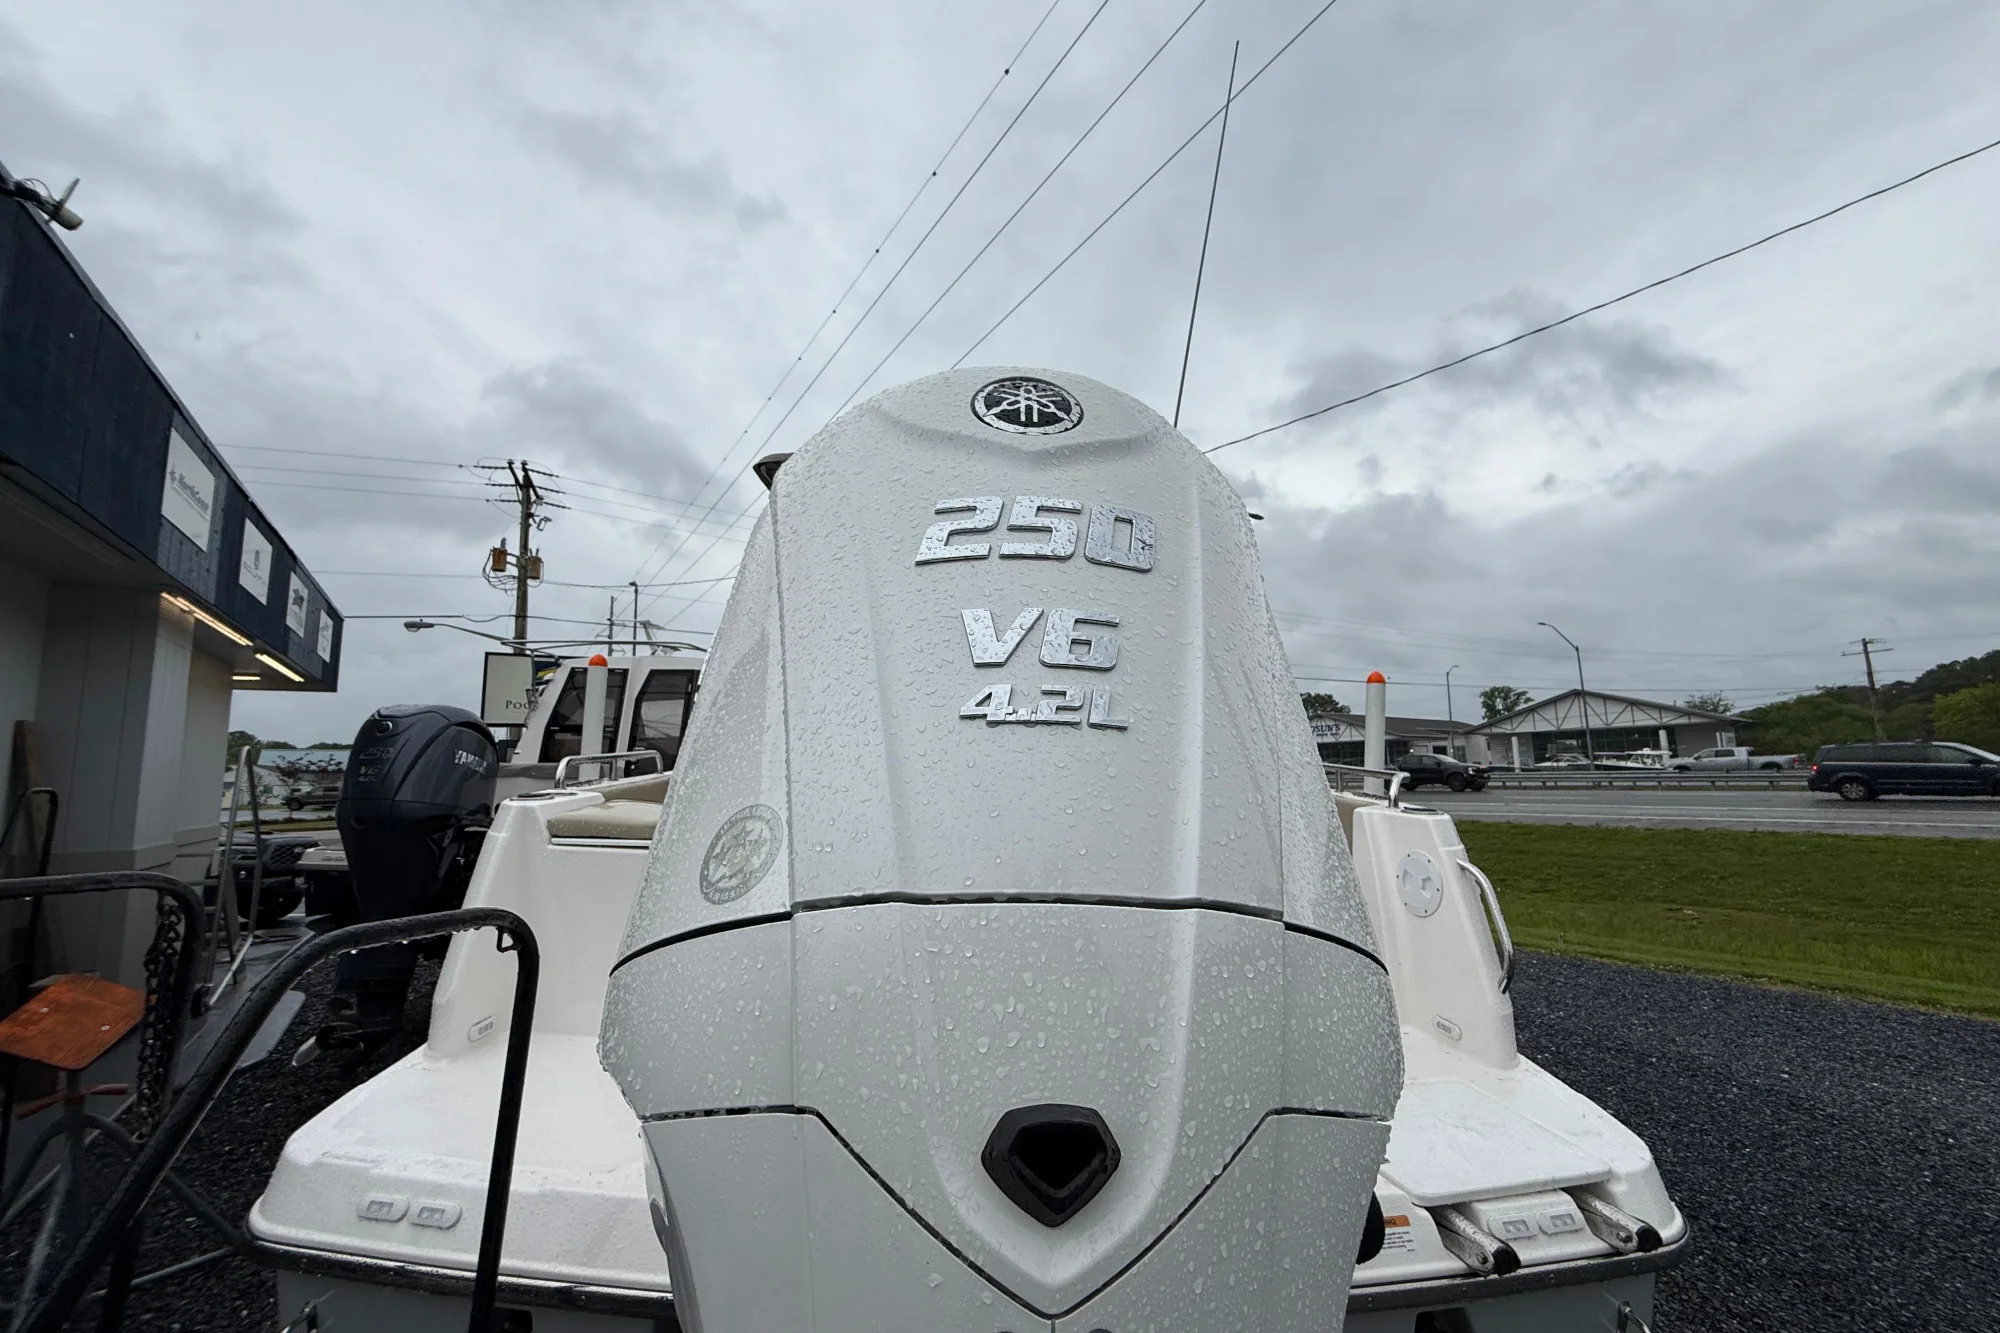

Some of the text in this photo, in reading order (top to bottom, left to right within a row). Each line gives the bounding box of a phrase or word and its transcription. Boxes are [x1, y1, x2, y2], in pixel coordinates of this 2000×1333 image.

[914, 495, 1157, 573] 250
[960, 607, 1121, 671] V6
[959, 683, 1129, 730] 4.2L
